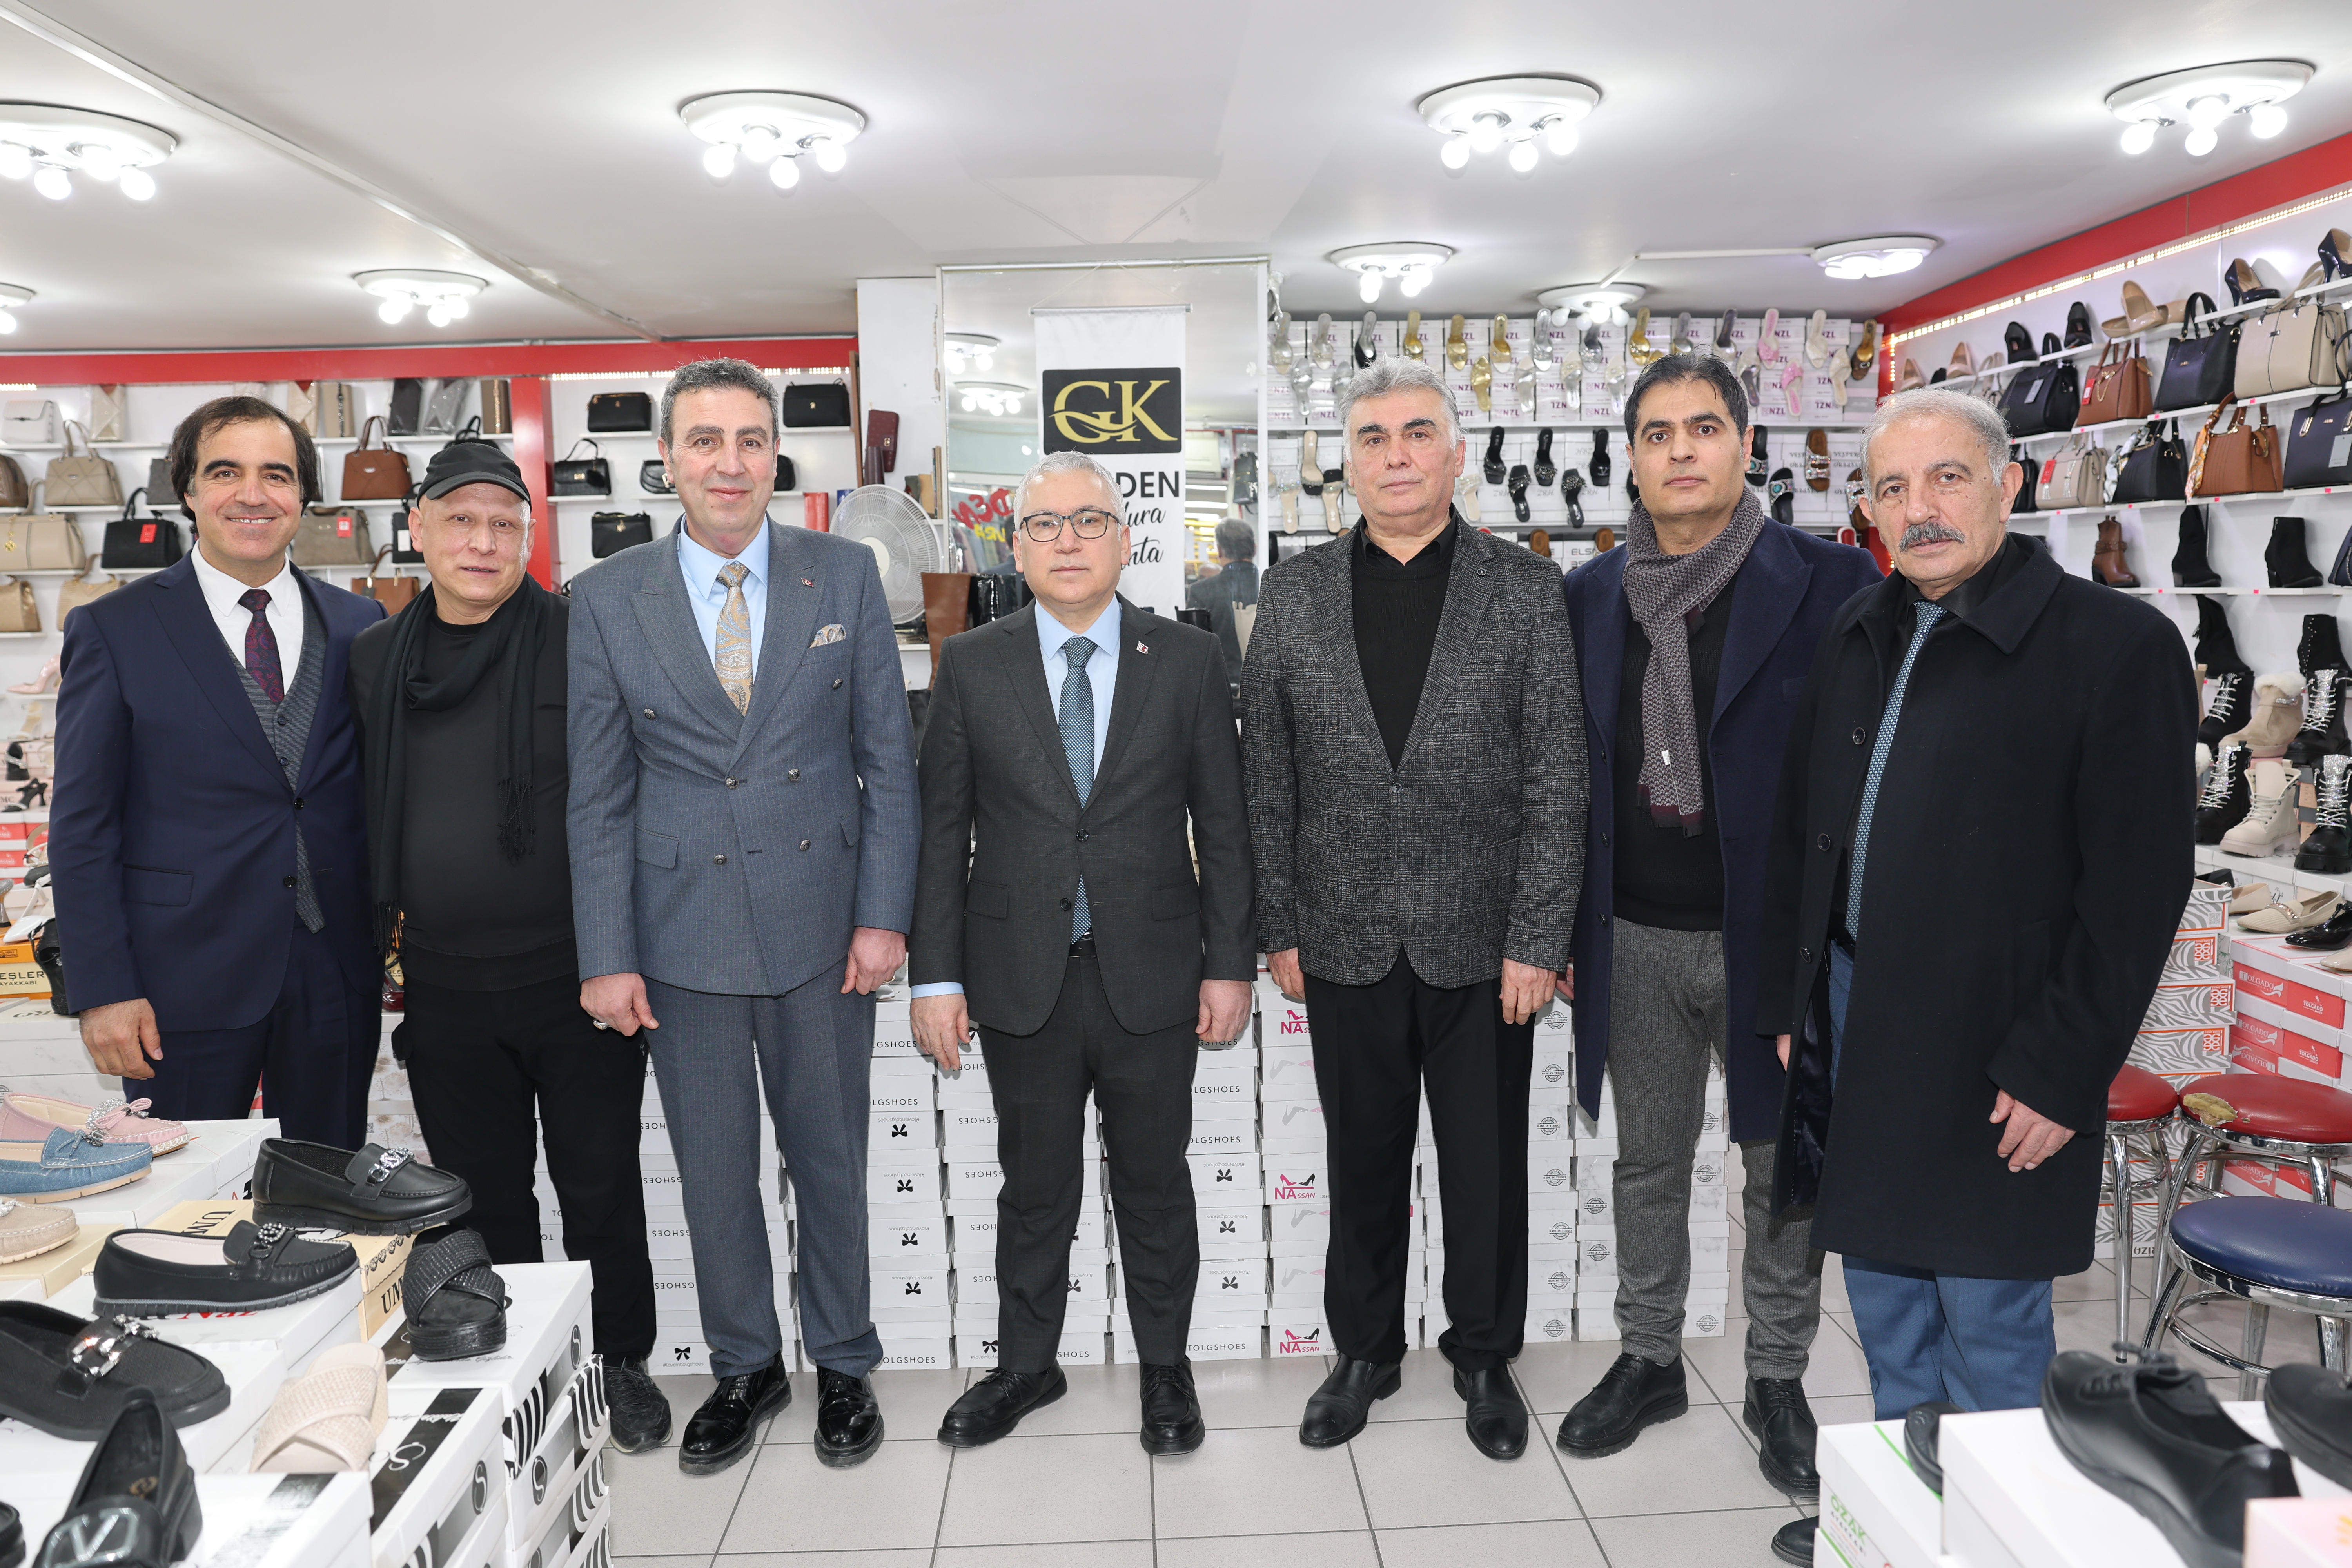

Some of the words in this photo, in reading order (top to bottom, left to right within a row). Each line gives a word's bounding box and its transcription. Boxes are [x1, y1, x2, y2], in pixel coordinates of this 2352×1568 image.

[1051, 380, 1178, 443] GK
[1116, 471, 1179, 498] DEN
[1125, 502, 1166, 527] ura
[1121, 536, 1164, 570] nta
[2239, 971, 2274, 989] TOLGADO
[2303, 1001, 2323, 1011] TOLGADO
[2299, 1050, 2319, 1062] TOLGADO
